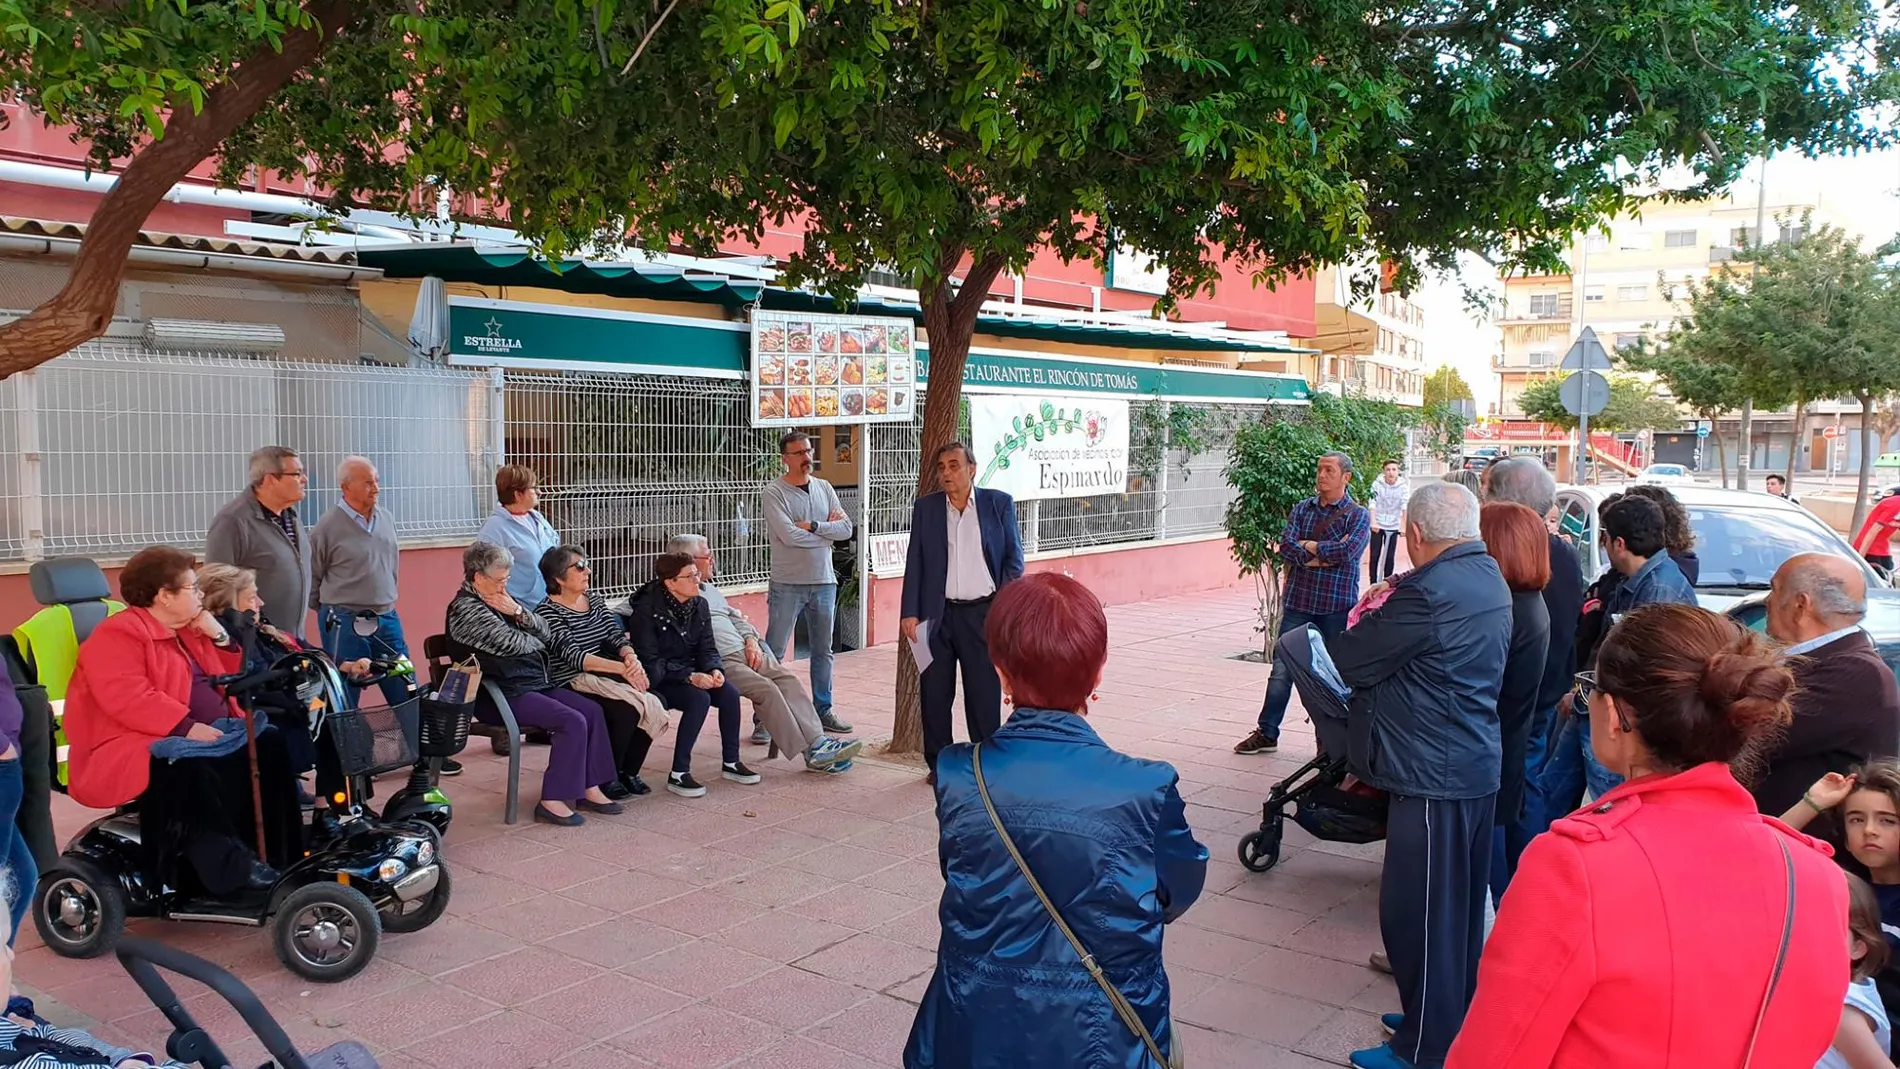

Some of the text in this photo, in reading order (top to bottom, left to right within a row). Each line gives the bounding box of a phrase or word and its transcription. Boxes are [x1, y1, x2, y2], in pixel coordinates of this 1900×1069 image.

[464, 336, 522, 348] ESTRELLA
[963, 363, 1031, 383] STAURANTE
[1034, 368, 1045, 383] EL
[1048, 368, 1089, 387] RINCÓN
[1091, 373, 1103, 388] DE
[1105, 372, 1137, 390] TOMÁS
[1072, 448, 1080, 459] de
[1040, 461, 1122, 494] Espinardo
[876, 540, 908, 566] MEN
